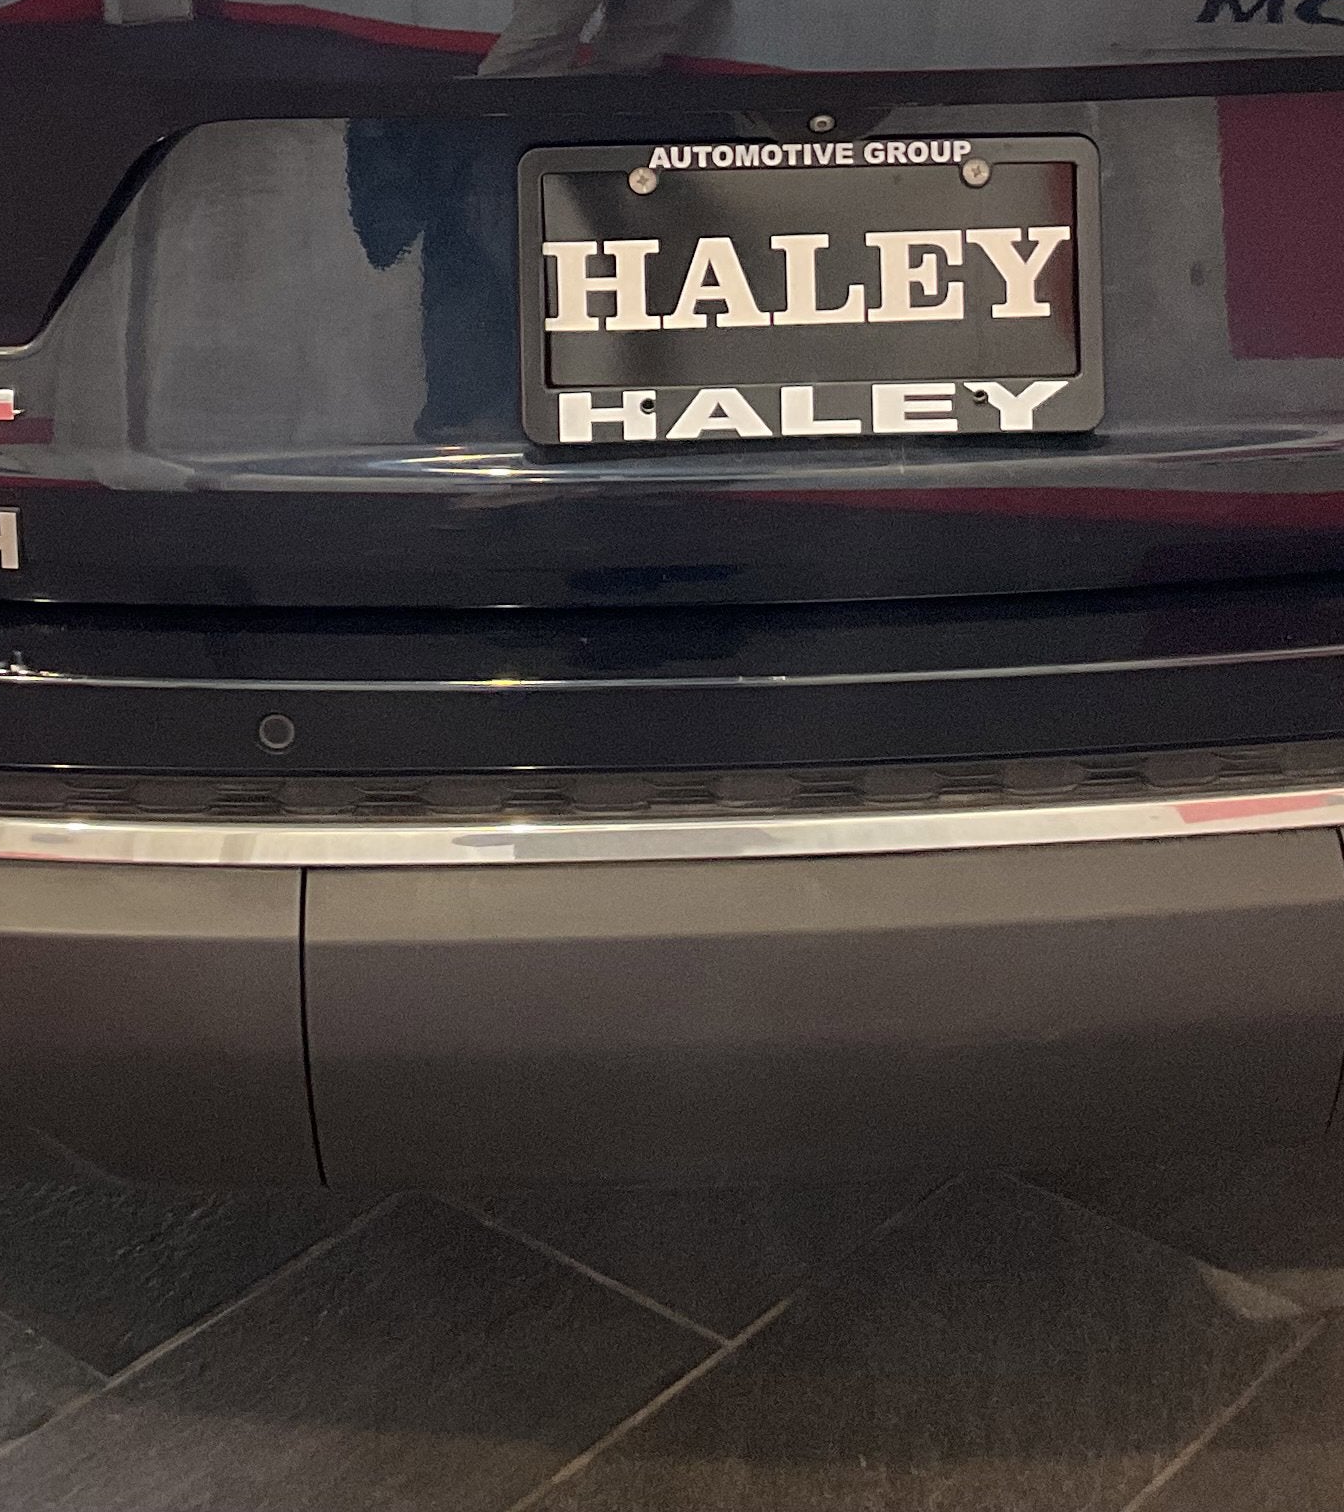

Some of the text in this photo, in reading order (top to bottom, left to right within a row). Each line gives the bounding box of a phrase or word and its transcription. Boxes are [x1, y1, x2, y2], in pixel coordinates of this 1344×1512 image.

[649, 139, 973, 170] AUTOMOTIVE GROUP
[542, 226, 1072, 332] HALEY
[558, 380, 1070, 443] HALEY
